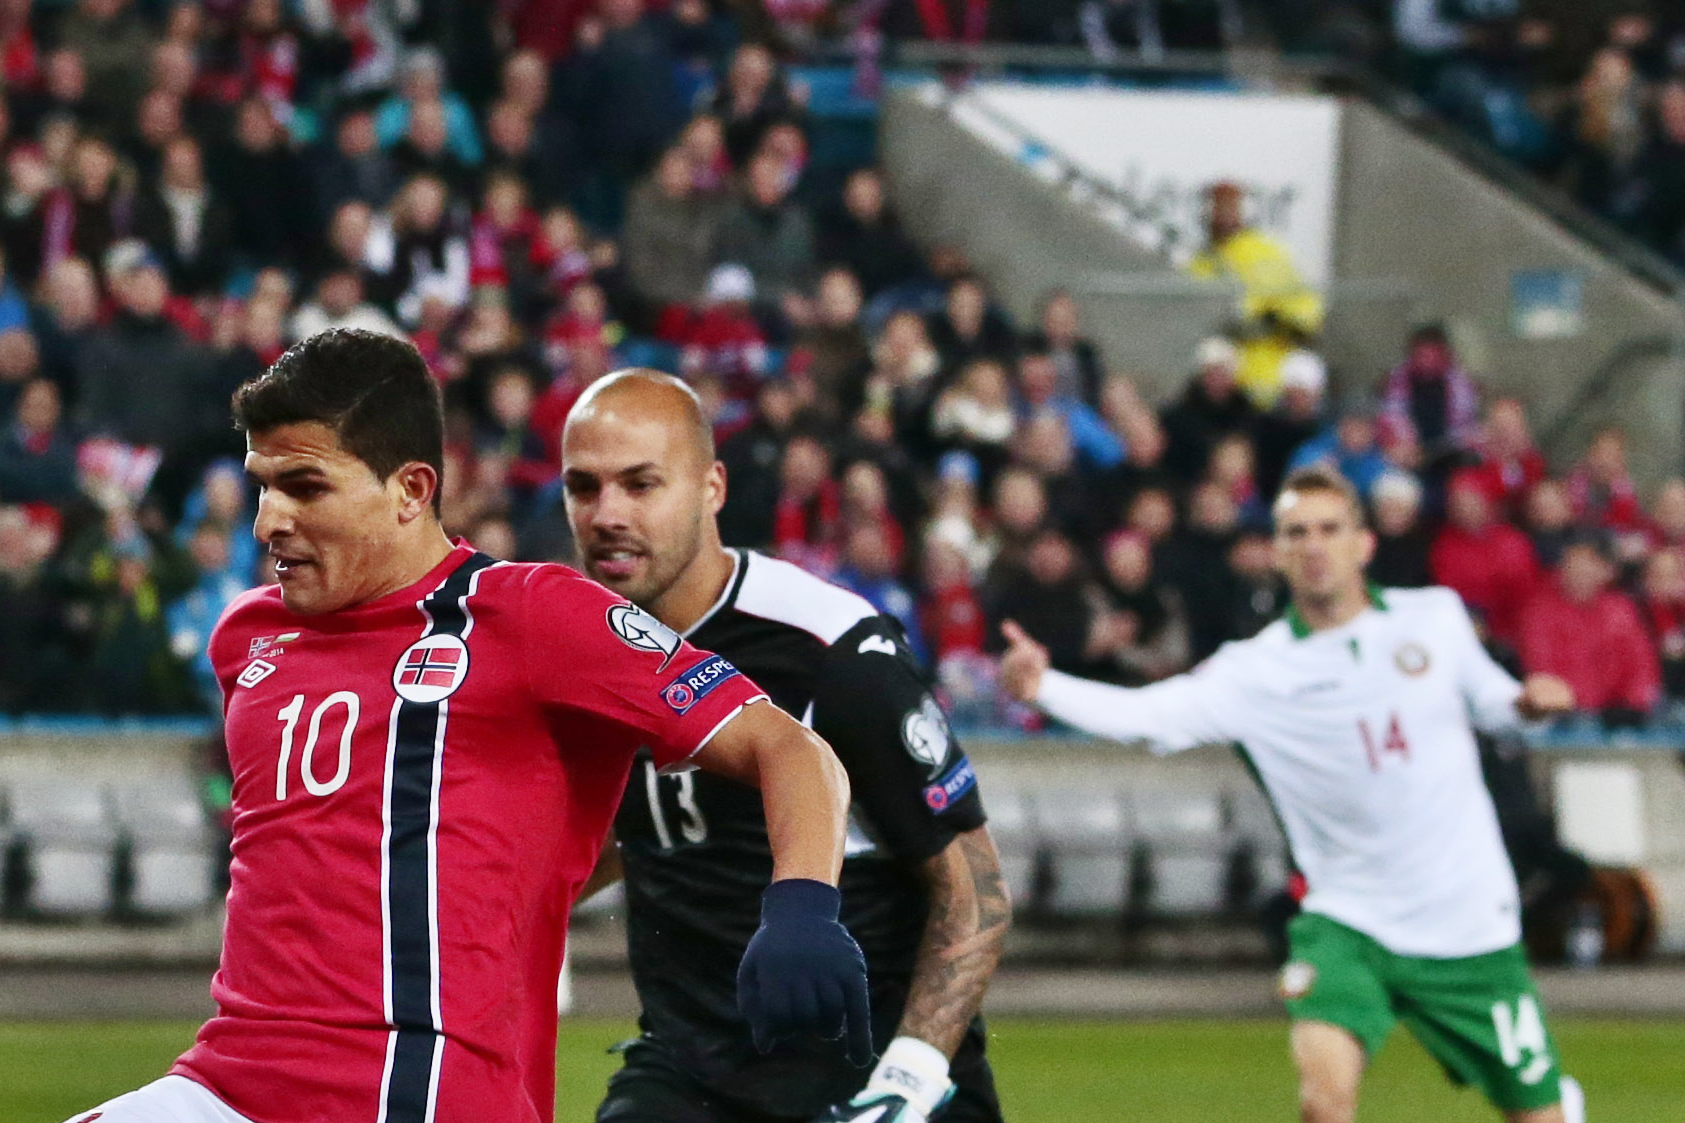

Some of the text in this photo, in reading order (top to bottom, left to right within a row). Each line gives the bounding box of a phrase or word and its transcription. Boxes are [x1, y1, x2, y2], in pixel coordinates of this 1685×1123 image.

[276, 691, 360, 800] 10
[1356, 709, 1411, 774] 14
[644, 760, 707, 849] 13
[1491, 994, 1547, 1068] 14
